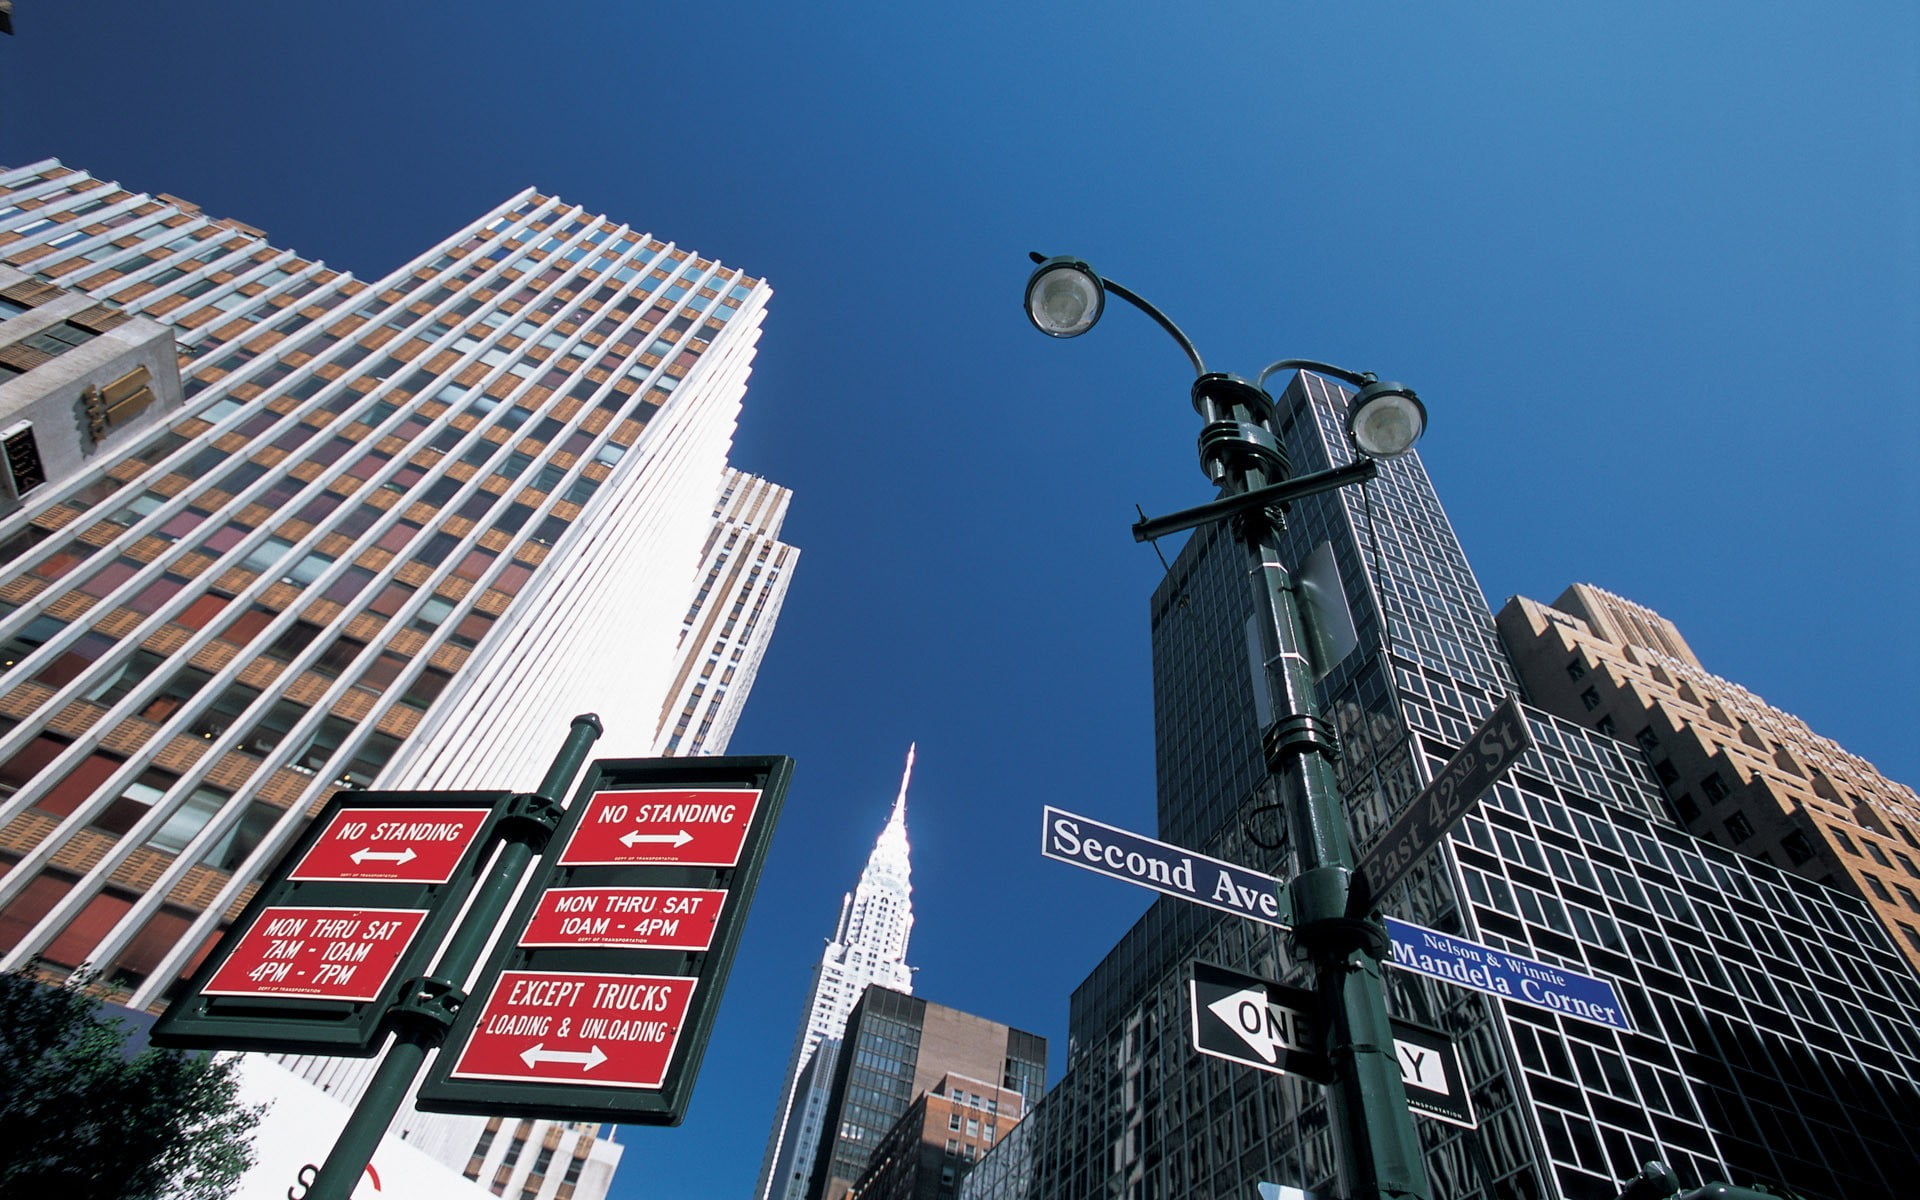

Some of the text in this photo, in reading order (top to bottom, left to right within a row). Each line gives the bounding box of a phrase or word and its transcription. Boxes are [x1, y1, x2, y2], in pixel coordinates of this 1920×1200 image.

[597, 804, 736, 824] NO STANDING
[1365, 821, 1424, 894] East
[1479, 721, 1519, 772] St
[336, 822, 463, 842] NO STANDING
[1053, 818, 1278, 918] Second Ave
[555, 896, 703, 915] MON THRU SAT
[263, 918, 402, 941] MON THRU SAT
[559, 917, 611, 935] 10AM
[634, 918, 679, 937] 4PM
[262, 940, 305, 960] 7AM
[321, 941, 374, 963] 10AM
[1422, 933, 1567, 987] Nelson & Winnie
[248, 962, 294, 983] 4PM
[311, 965, 357, 986] 7PM
[1391, 939, 1619, 1026] Mandela Corner
[508, 980, 672, 1012] EXCEPT TRUCKS
[486, 1014, 668, 1043] LOADING & UNLOADING
[1238, 1000, 1314, 1049] ONE
